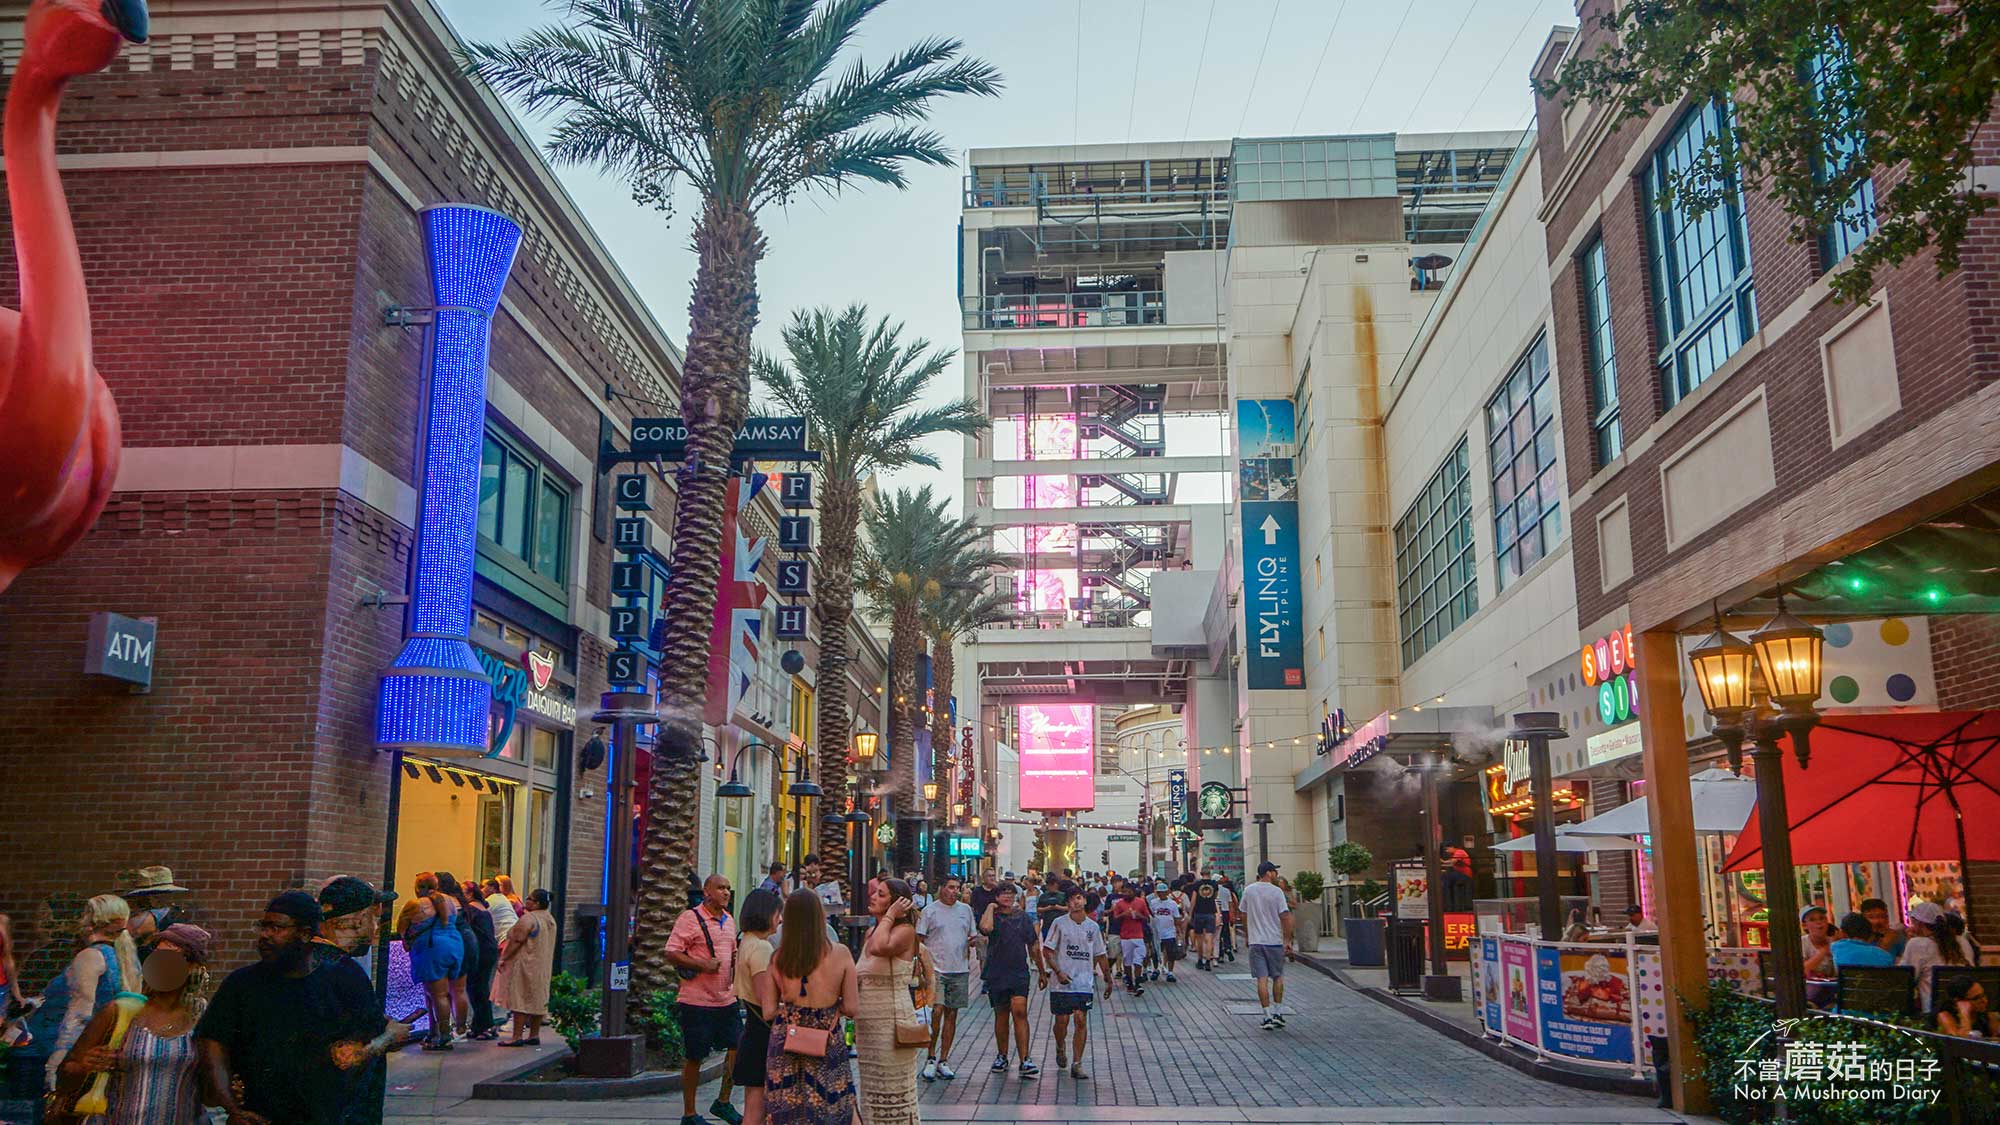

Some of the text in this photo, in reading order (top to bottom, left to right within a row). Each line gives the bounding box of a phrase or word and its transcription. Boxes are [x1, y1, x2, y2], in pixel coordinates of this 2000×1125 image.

[633, 425, 803, 441] GORD AMSAY
[781, 476, 806, 632] FISH
[615, 478, 642, 679] CHIPS
[1279, 556, 1290, 626] ZIPLINE
[1257, 557, 1281, 658] FLYLINQ
[108, 631, 152, 667] ATM
[1585, 632, 1635, 678] SWEE
[528, 690, 577, 726] DAIQUIRI BAR
[1447, 923, 1475, 934] ERS
